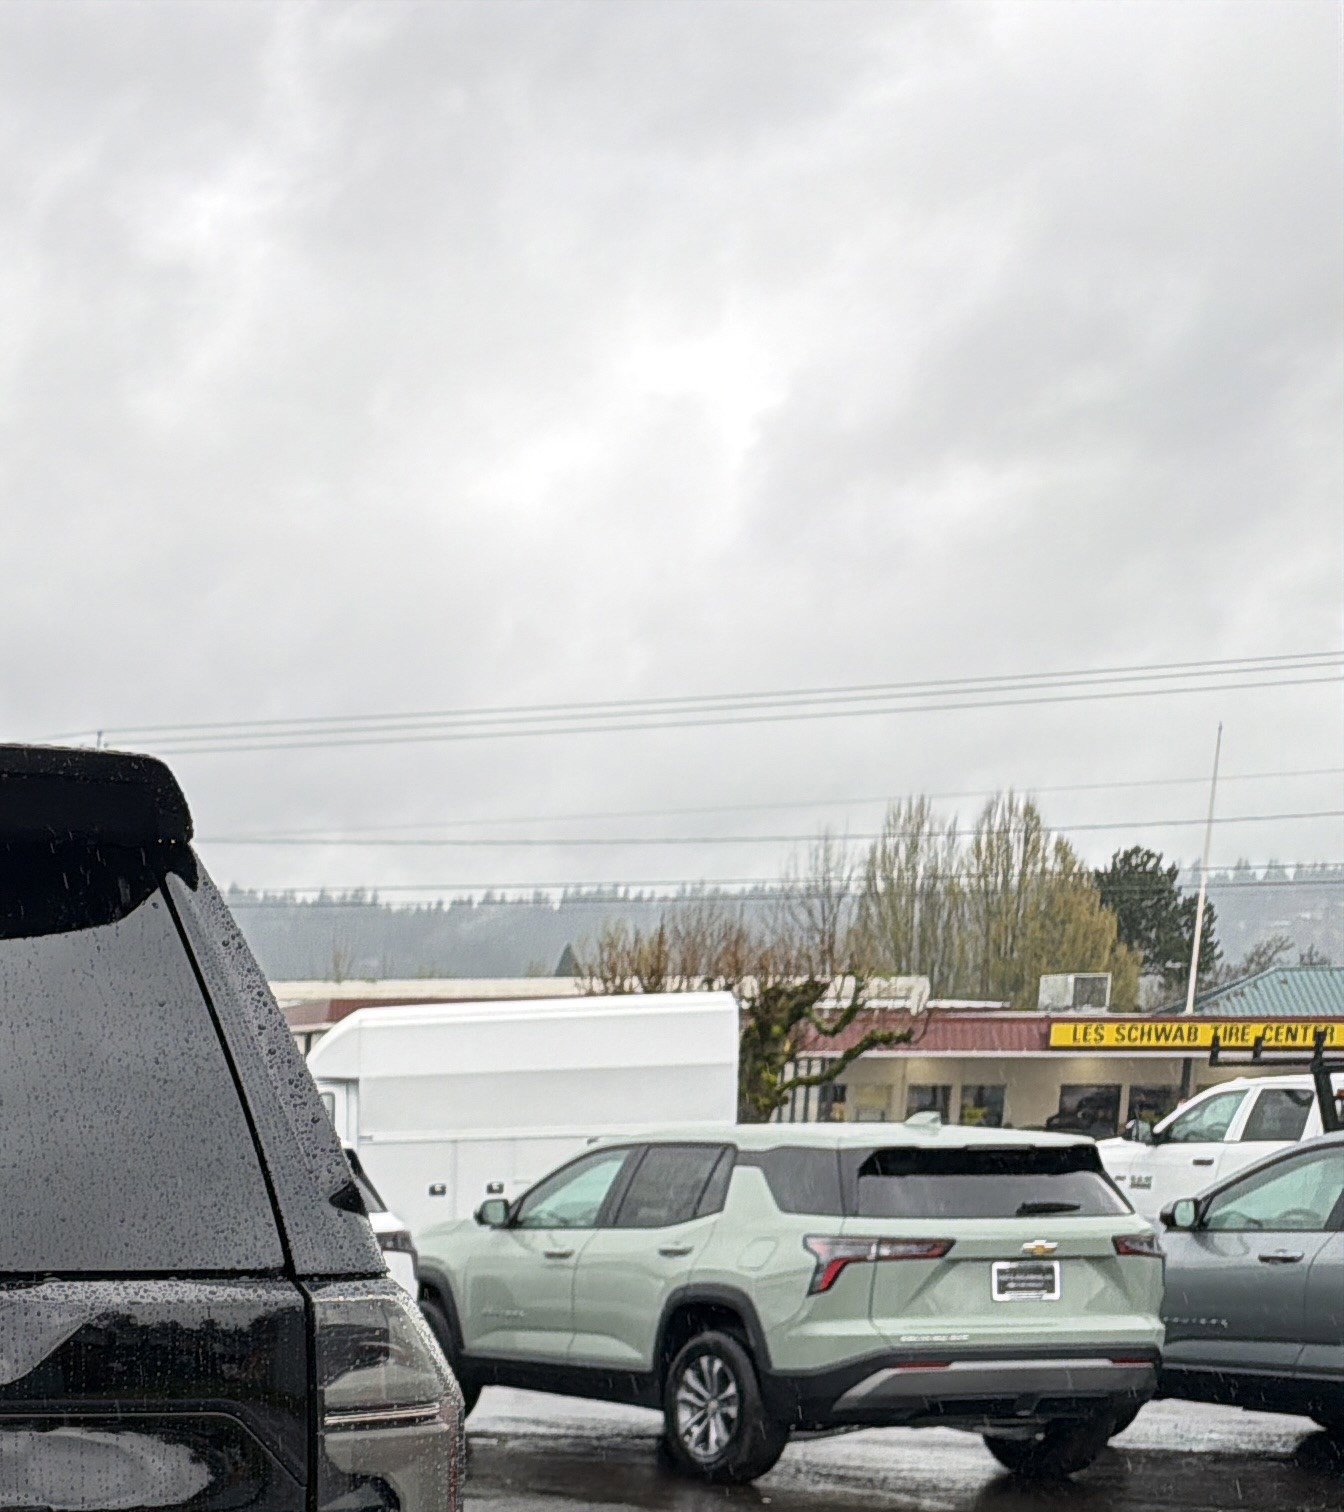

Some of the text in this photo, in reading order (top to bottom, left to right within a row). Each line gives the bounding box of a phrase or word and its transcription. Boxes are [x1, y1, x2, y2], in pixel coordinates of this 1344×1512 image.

[1071, 1022, 1105, 1043] LES
[1114, 1022, 1200, 1043] SCHWAB
[1211, 1023, 1251, 1043] TIRE
